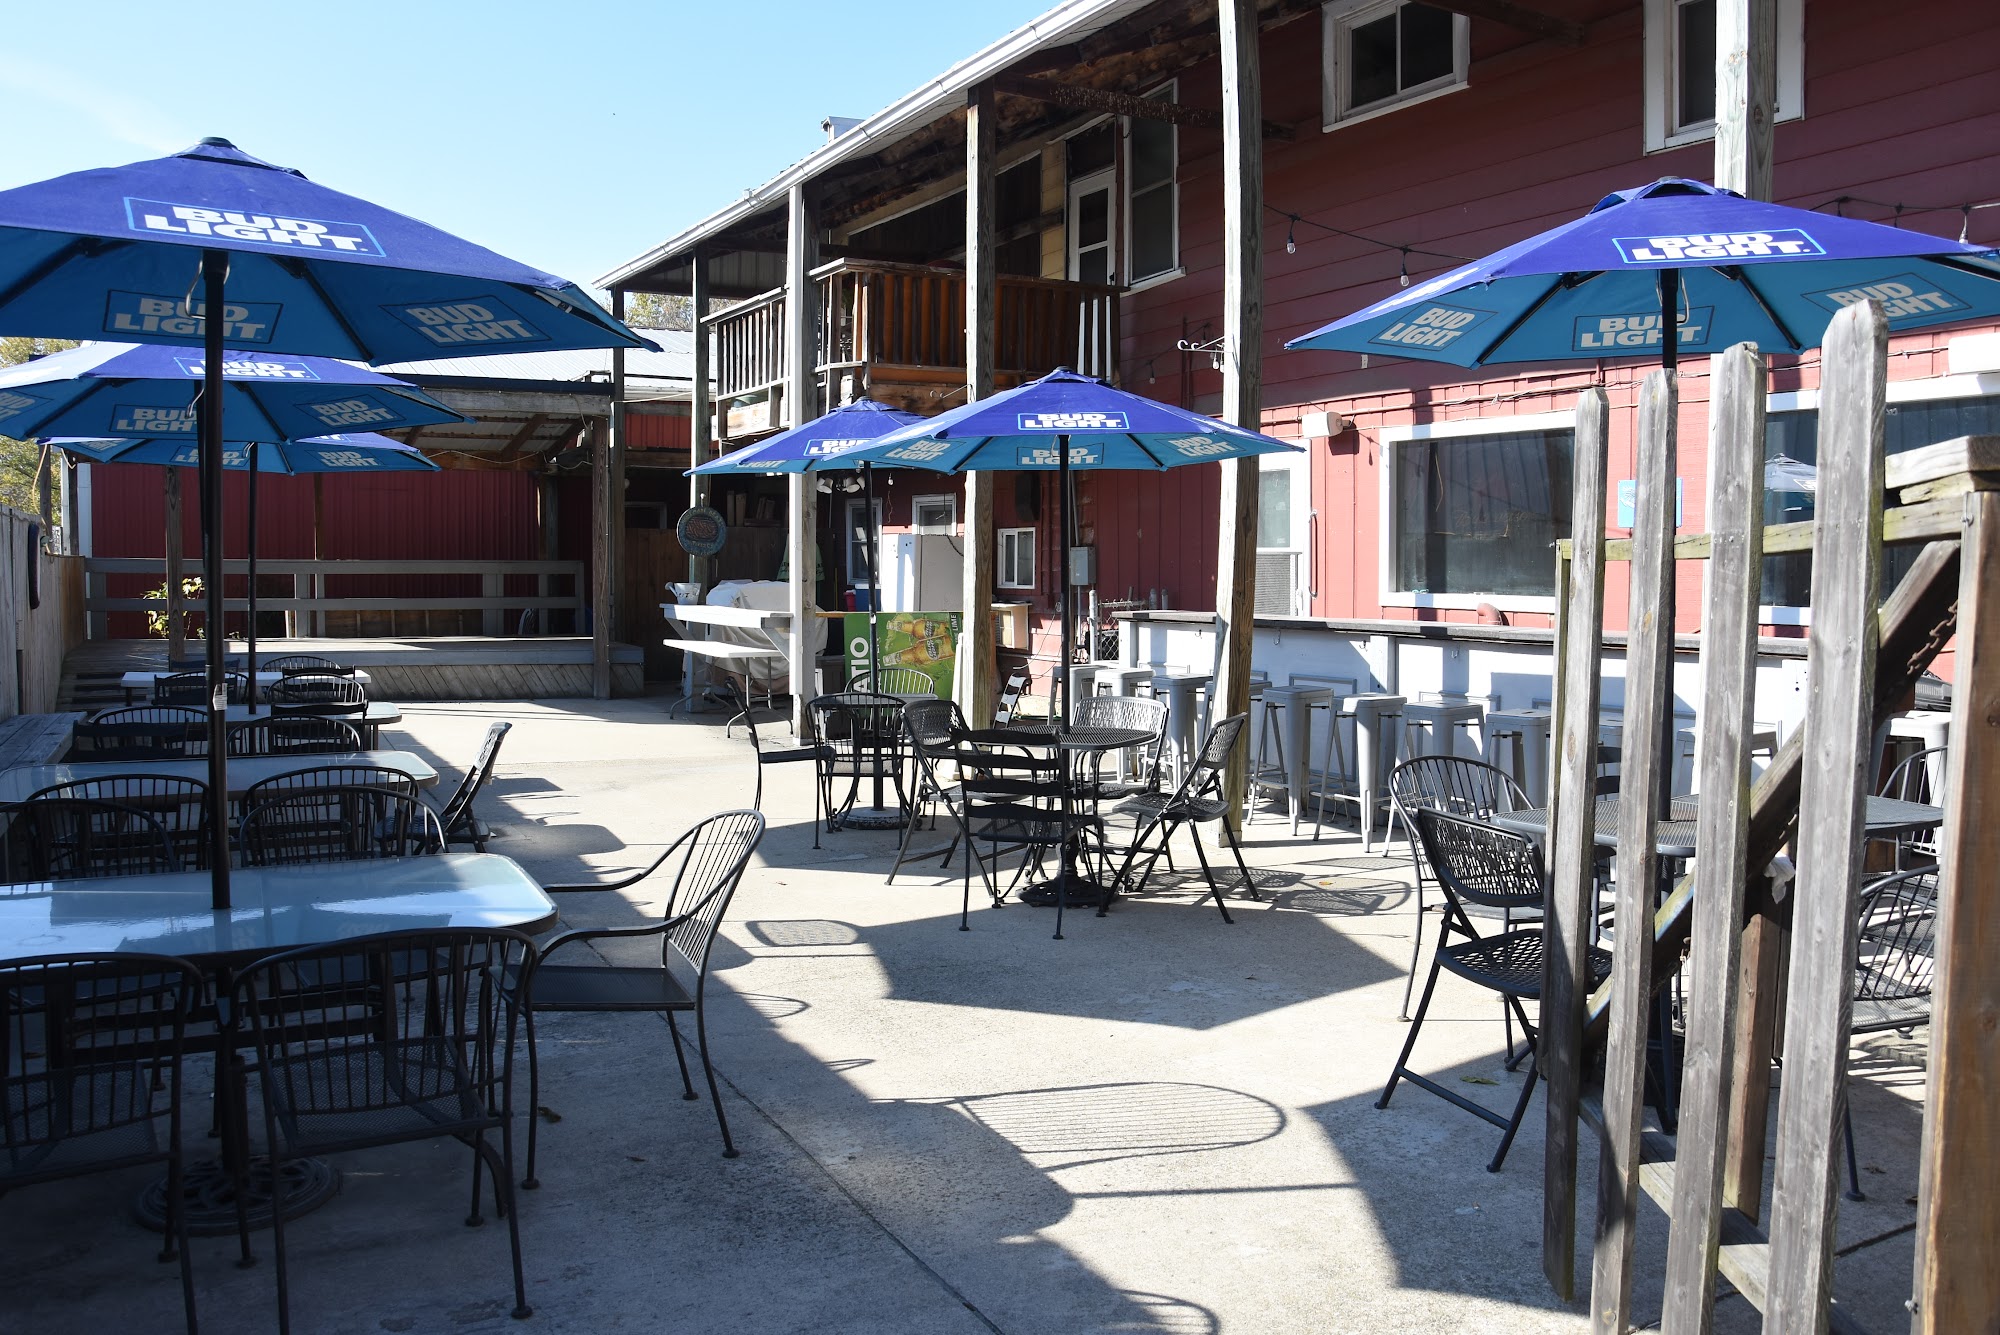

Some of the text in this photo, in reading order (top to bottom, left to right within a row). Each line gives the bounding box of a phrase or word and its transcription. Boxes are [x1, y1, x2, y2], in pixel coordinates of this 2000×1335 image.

[172, 206, 328, 234] BUD
[144, 214, 364, 252] LIGHT
[1648, 233, 1773, 249] BUD
[1631, 240, 1805, 260] LIGHT
[139, 298, 249, 322] BUD
[1883, 292, 1953, 317] GHT
[405, 303, 495, 326] BUD
[1412, 307, 1475, 329] BUD
[418, 319, 533, 343] LIGHT
[1378, 322, 1463, 347] LIGHT
[1581, 326, 1702, 348] LIGHT
[189, 366, 307, 378] LGHT
[311, 399, 369, 416] BUD
[116, 419, 197, 432] LIGH
[319, 408, 395, 426] LIGHT
[1024, 419, 1121, 428] LIGHT
[1037, 413, 1107, 421] BUD
[907, 439, 951, 452] BUD
[1168, 436, 1213, 449] BUD
[1177, 441, 1236, 457] LIGHT
[318, 451, 362, 459] BUD
[321, 457, 378, 467] LIGHT
[885, 447, 944, 461] LIGHT
[1021, 454, 1098, 465] LIGHT
[850, 637, 869, 694] ATIO
